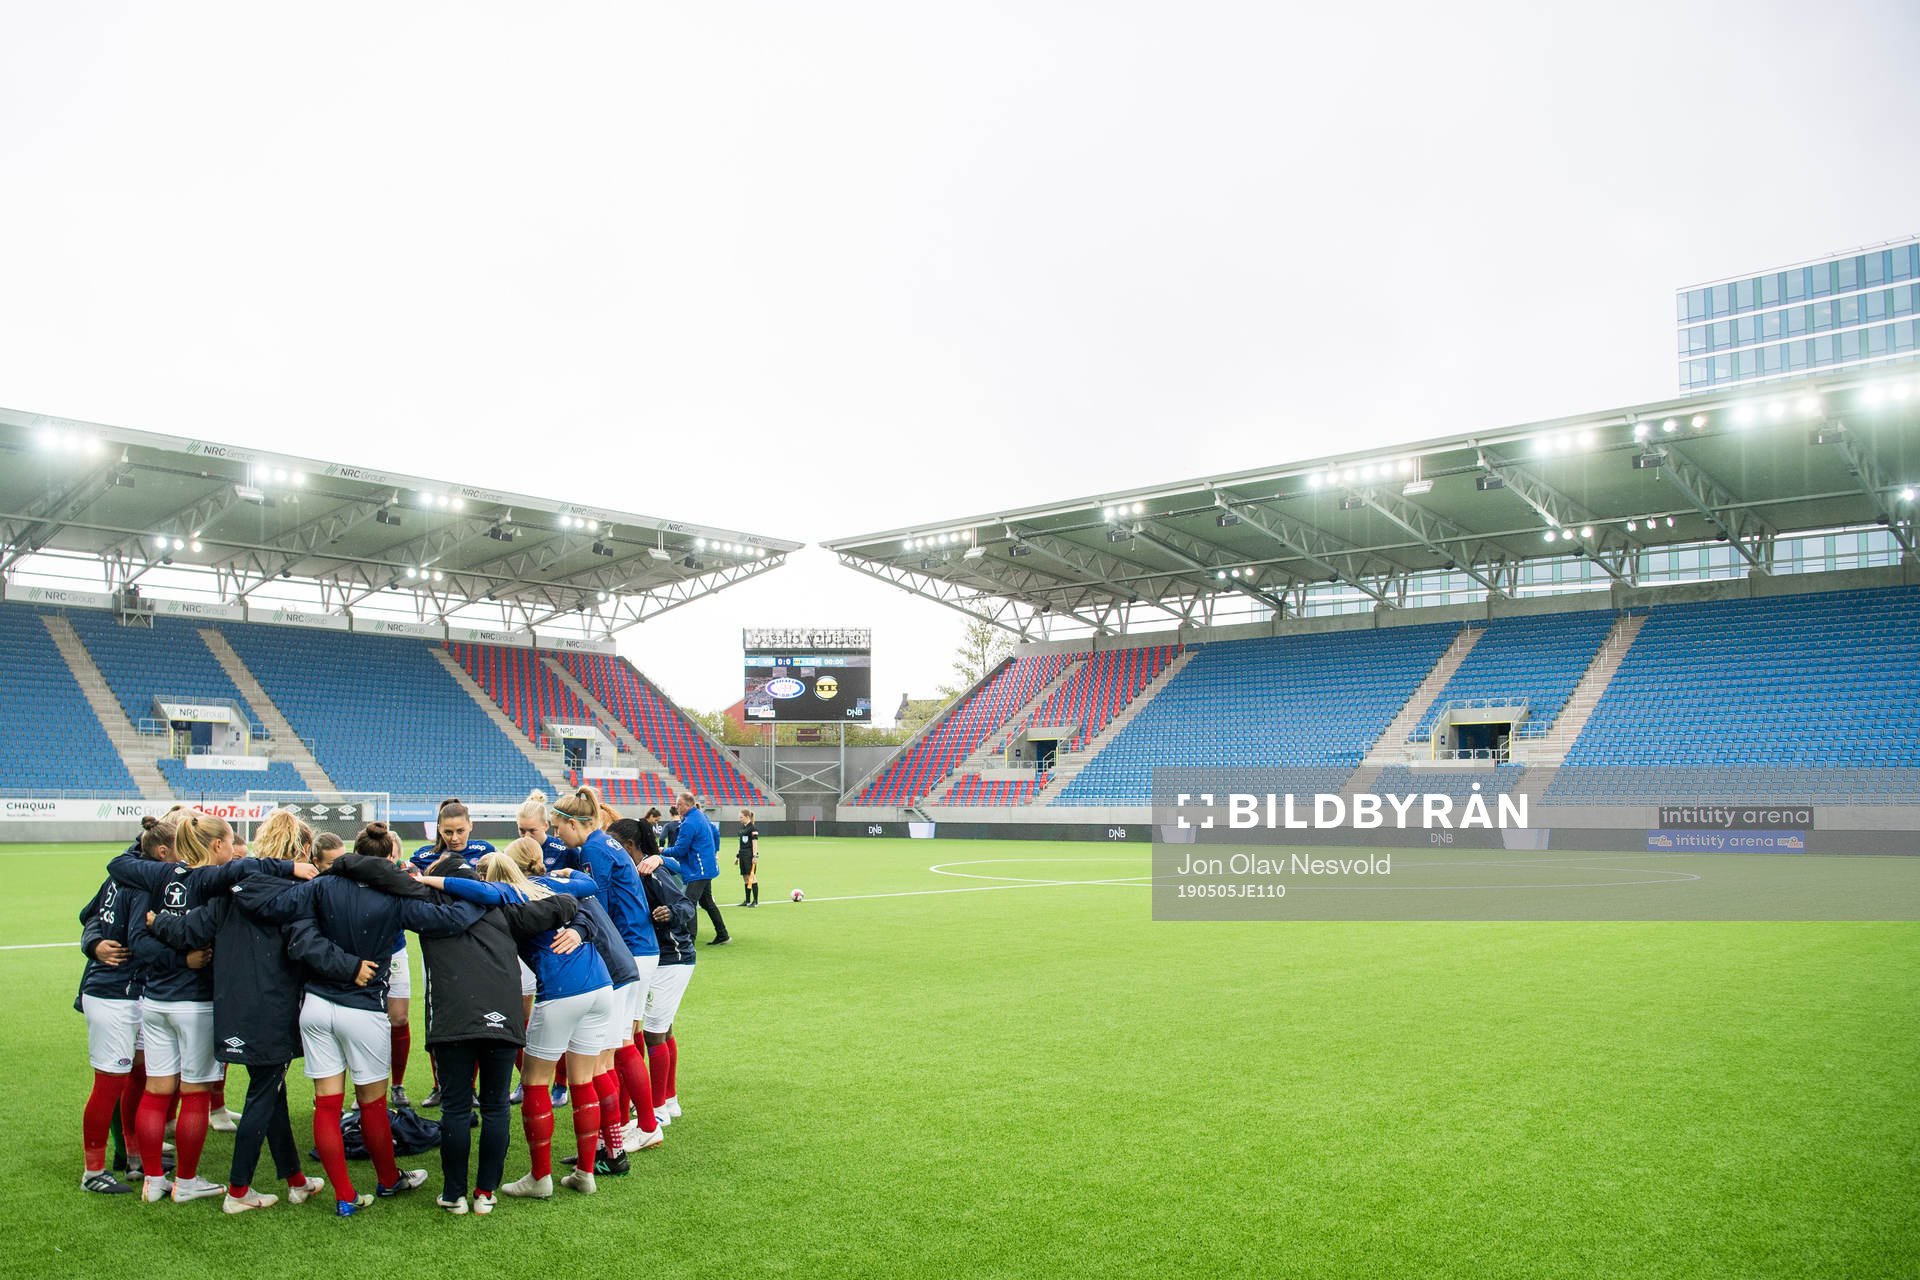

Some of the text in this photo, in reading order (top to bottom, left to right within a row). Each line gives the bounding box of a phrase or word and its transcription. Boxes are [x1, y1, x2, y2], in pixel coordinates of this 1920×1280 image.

[204, 445, 255, 462] NRC Group
[340, 467, 386, 483] NRC Group
[461, 488, 479, 498] NRC
[570, 506, 587, 516] NRC
[668, 523, 683, 532] NRC
[45, 591, 96, 605] NRC Group
[182, 603, 228, 617] NRC Group
[286, 613, 327, 625] NRC Group
[387, 623, 426, 635] NRC Group
[480, 632, 515, 643] NRC Group
[566, 640, 580, 649] NRC
[180, 708, 199, 718] NRC
[846, 706, 863, 718] DNB
[6, 802, 56, 812] CHAQWA
[117, 806, 165, 817] NRC Gro
[1662, 806, 1809, 828] intility arena
[868, 823, 883, 836] DNB
[1108, 826, 1126, 840] DNB
[1430, 830, 1454, 847] DNB
[1675, 834, 1725, 849] intility
[1729, 837, 1773, 847] arena
